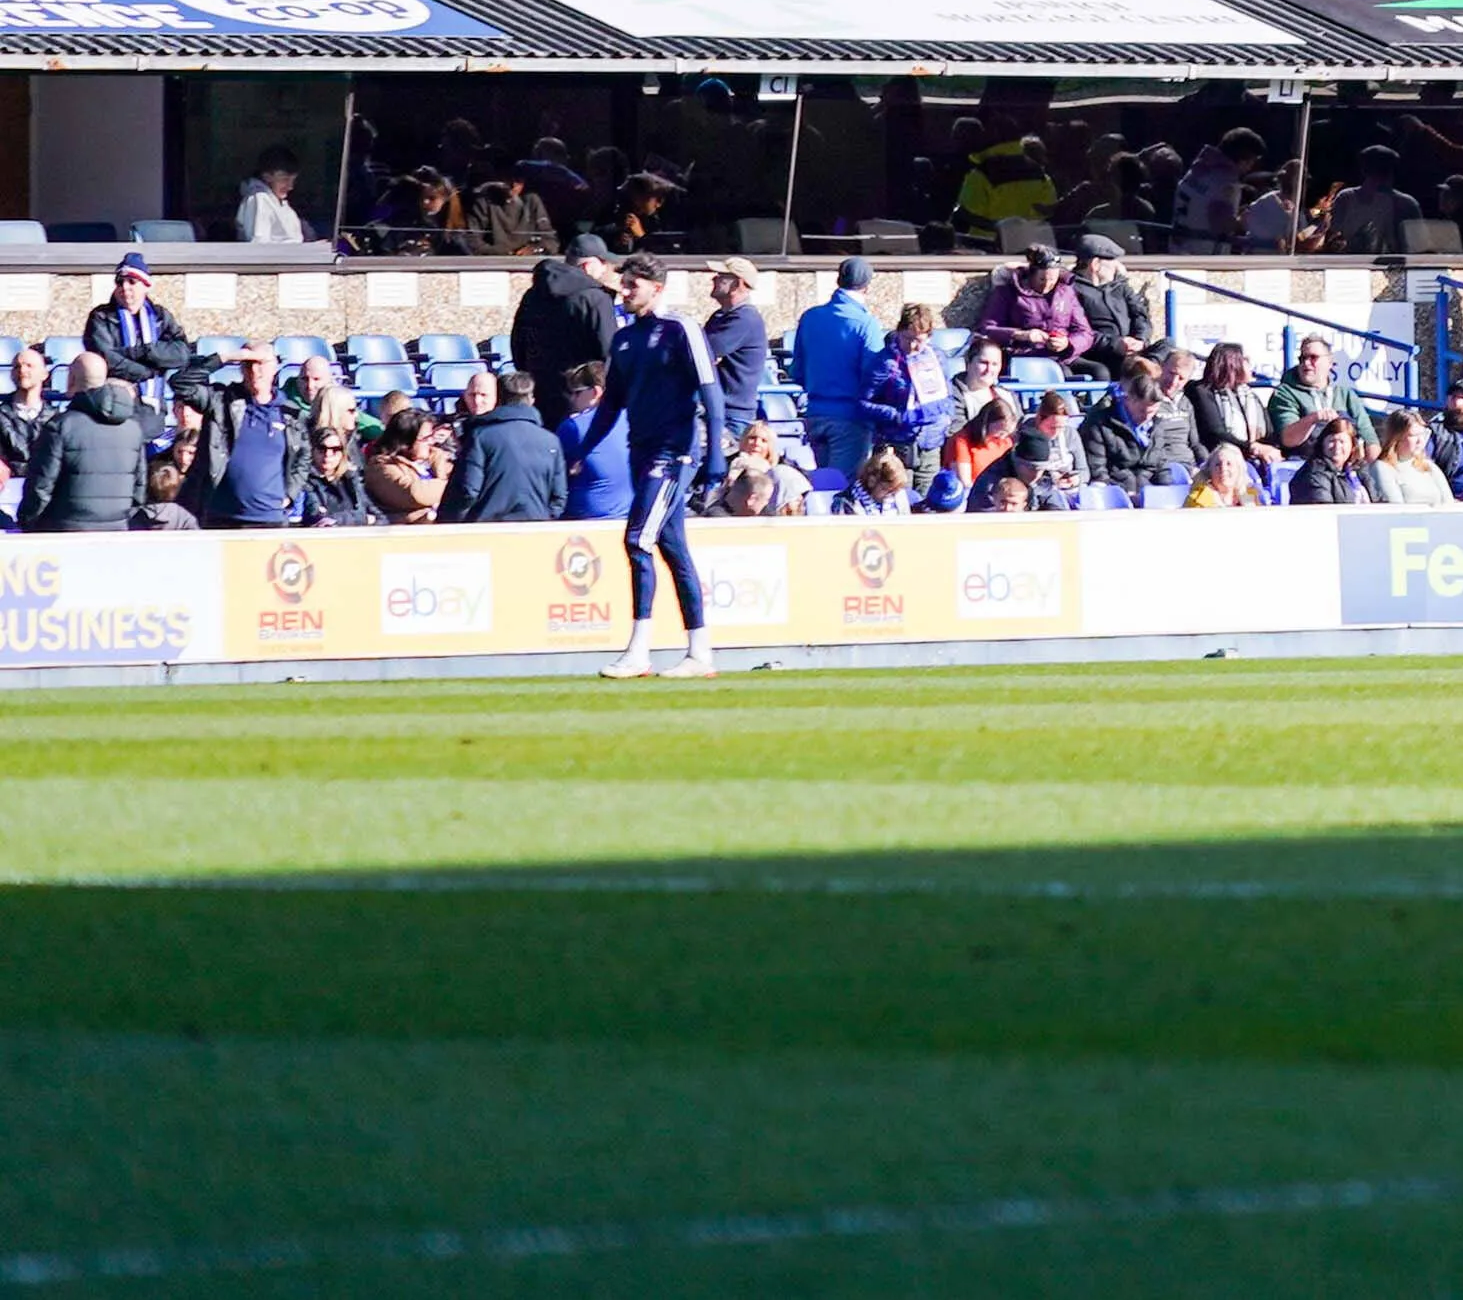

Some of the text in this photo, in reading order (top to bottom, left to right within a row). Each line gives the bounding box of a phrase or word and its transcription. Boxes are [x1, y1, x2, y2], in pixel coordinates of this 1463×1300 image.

[245, 0, 409, 22] co-op
[1348, 360, 1404, 382] ONLY
[964, 561, 1054, 610] ebay
[387, 574, 486, 626] ebay
[844, 595, 903, 614] REN
[260, 611, 323, 631] REN
[548, 602, 610, 622] REN
